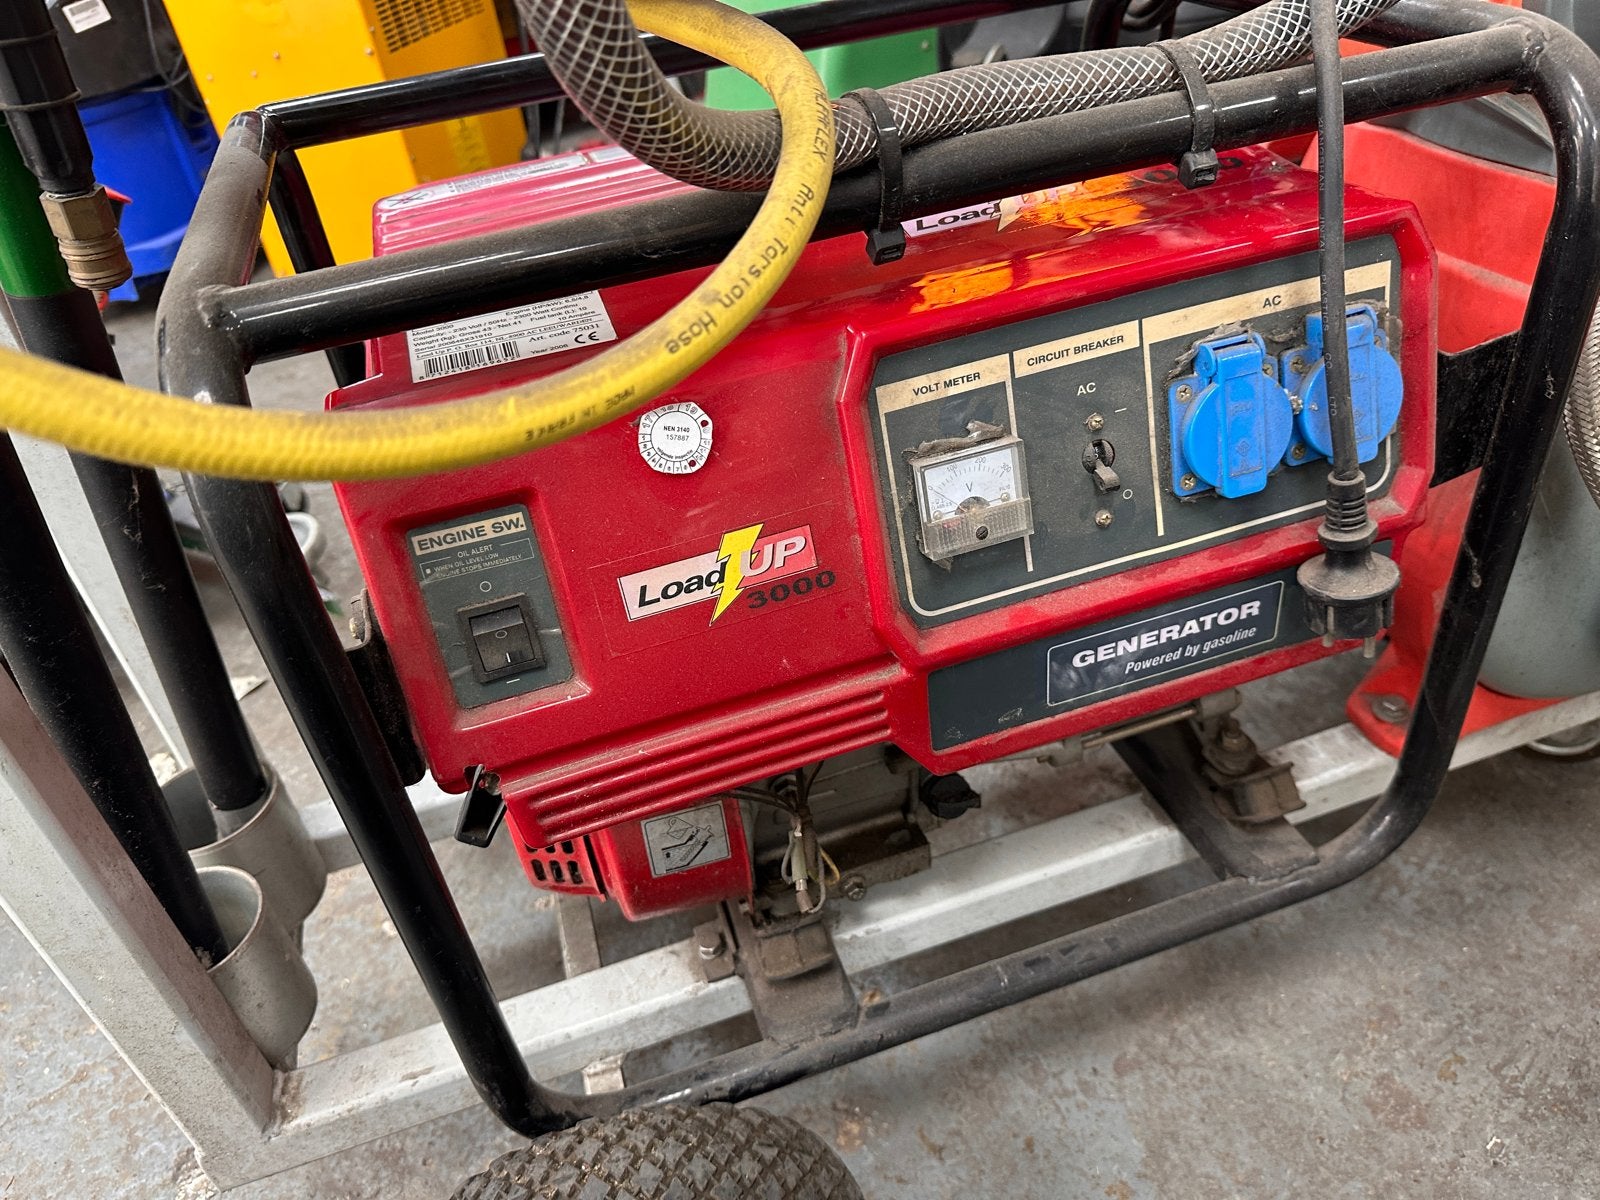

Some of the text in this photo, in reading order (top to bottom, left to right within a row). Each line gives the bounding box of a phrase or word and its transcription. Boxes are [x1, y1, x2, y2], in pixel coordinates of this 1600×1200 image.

[785, 182, 815, 229] Anti
[719, 238, 790, 310] Torsion
[505, 308, 530, 316] Engine
[1262, 294, 1282, 310] AC
[513, 312, 532, 320] 2300
[533, 308, 549, 316] Watt
[412, 328, 434, 336] Model
[413, 338, 439, 347] Weight
[459, 329, 480, 338] Gross
[547, 311, 562, 319] tank
[528, 324, 600, 343] Art. code 75031
[665, 310, 718, 355] Hose
[414, 343, 436, 353] Serial
[416, 351, 434, 359] Load
[1026, 335, 1125, 367] CIRCUIT BREAKER
[912, 371, 981, 397] VOLT METER
[1076, 381, 1097, 396] AC
[946, 463, 958, 472] 100
[974, 456, 987, 464] 200
[965, 482, 973, 493] V
[417, 516, 525, 552] ENGINE SW.
[457, 544, 494, 559] OIL ALERT
[433, 552, 500, 573] WHEN OIL LEVEL LOW
[461, 563, 482, 573] STOPS
[482, 553, 522, 569] IMMEDIATELY
[638, 535, 806, 608] Load UP
[746, 570, 836, 609] 3000
[1072, 600, 1261, 668] GENERATOR
[1124, 626, 1257, 674] Powered by gasoline
